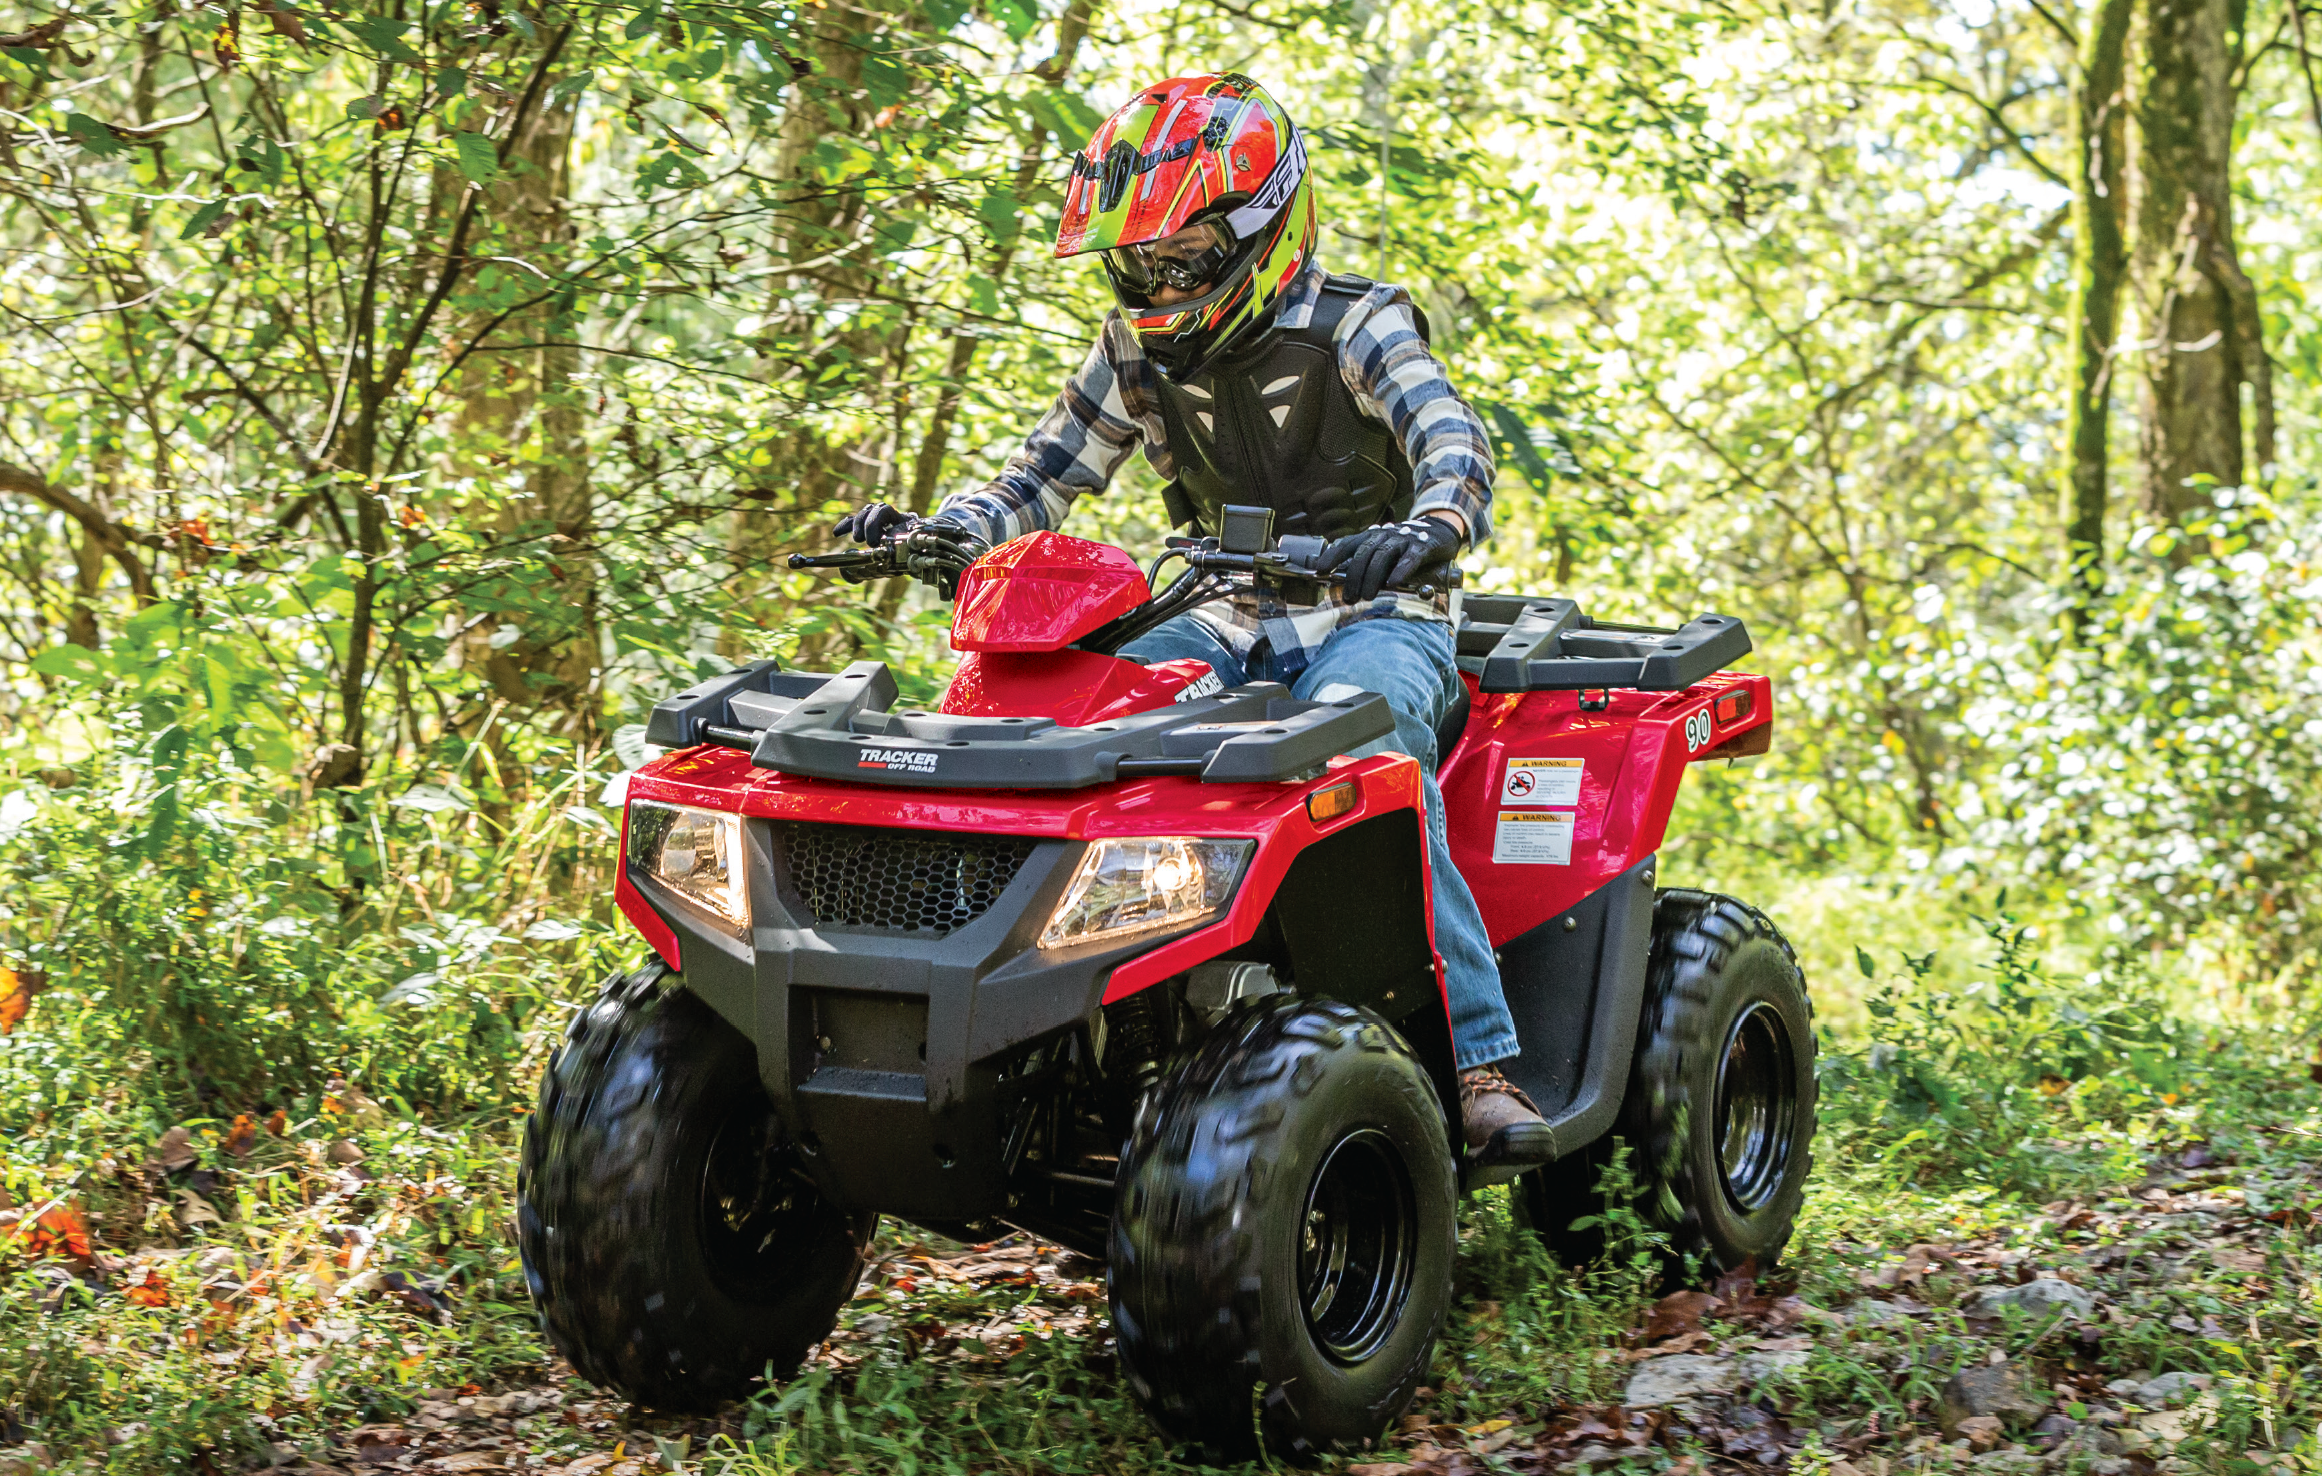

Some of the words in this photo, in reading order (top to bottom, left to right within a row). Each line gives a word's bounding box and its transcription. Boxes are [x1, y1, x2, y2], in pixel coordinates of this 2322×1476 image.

[1685, 708, 1711, 753] 90
[860, 749, 939, 766] TRACKER
[908, 764, 936, 773] ROAD
[1522, 814, 1561, 822] WARNING
